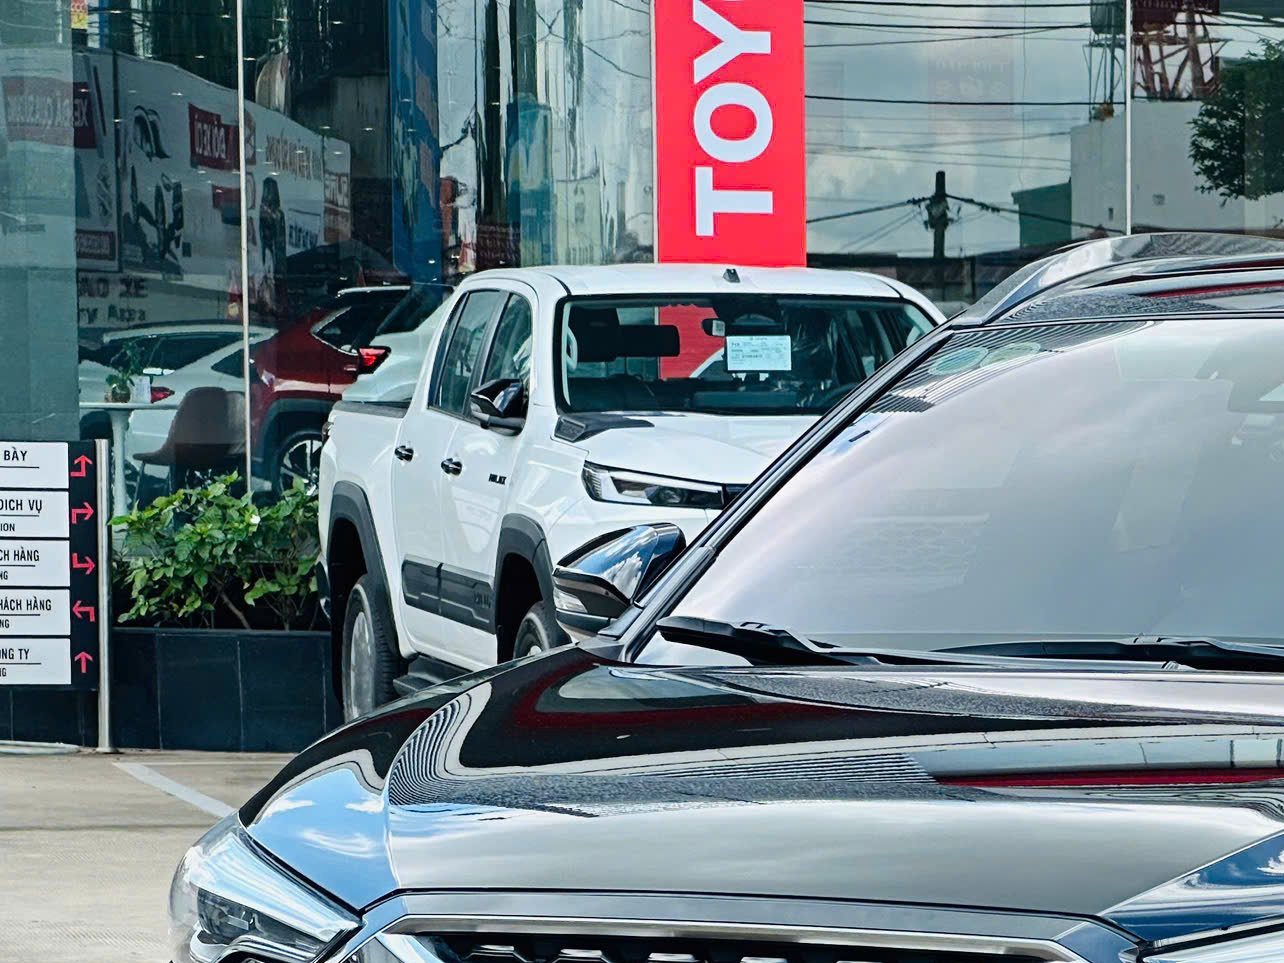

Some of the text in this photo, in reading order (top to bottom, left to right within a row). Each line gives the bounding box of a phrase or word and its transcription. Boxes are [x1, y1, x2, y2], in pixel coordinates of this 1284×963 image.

[3, 446, 28, 461] BÀY
[28, 499, 43, 514] VỤ
[13, 545, 40, 562] HÀNG
[26, 595, 52, 611] HÀNG
[18, 648, 30, 660] TY
